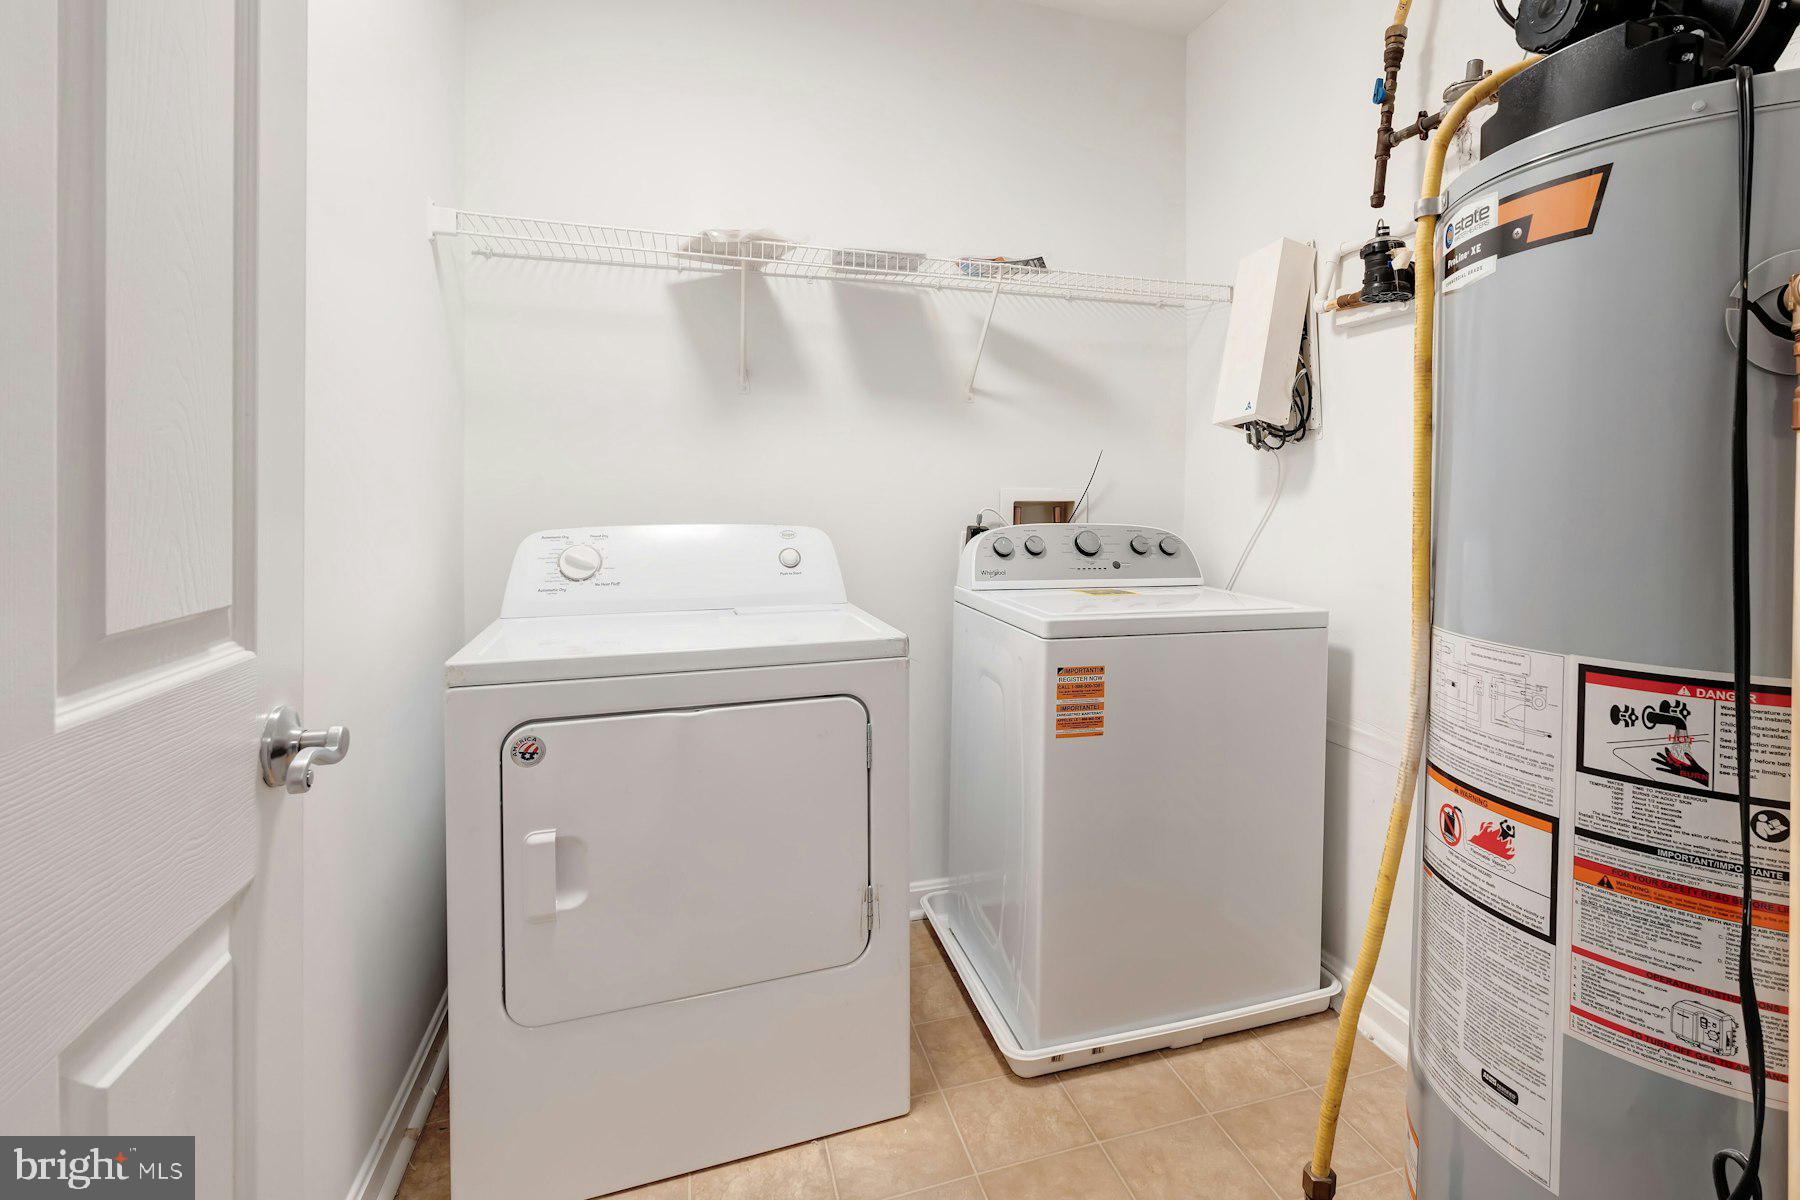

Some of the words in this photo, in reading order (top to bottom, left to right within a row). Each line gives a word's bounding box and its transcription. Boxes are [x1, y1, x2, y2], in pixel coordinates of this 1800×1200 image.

[1454, 205, 1490, 235] state
[1471, 243, 1482, 256] XE
[981, 569, 1006, 578] Whirlpool
[1696, 688, 1757, 704] DANGR
[1589, 780, 1624, 792] TEMPERATURE
[1632, 824, 1651, 834] Mixing
[1653, 829, 1673, 838] Valves
[1657, 848, 1784, 880] IMPORTANT/IMPOTANTE
[1612, 868, 1630, 878] FOR
[1633, 875, 1660, 886] YOUR
